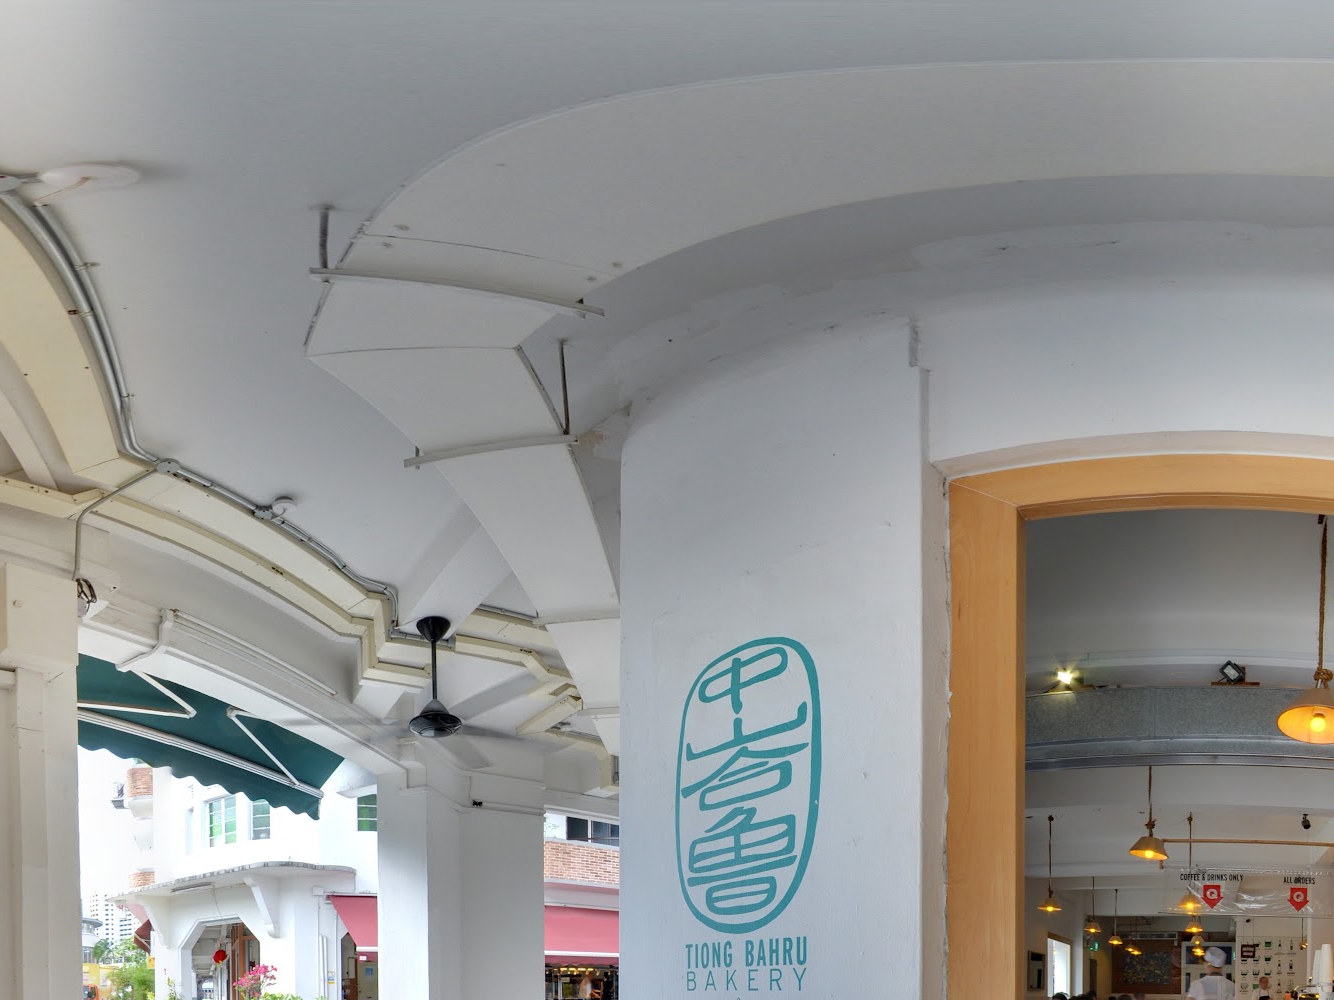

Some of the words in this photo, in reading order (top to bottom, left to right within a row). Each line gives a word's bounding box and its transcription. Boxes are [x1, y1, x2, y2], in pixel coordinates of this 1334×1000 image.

[1180, 873, 1200, 881] COFFEE
[1207, 874, 1228, 882] DRINKS
[1229, 874, 1244, 882] ONLY
[1283, 876, 1292, 884] ALL
[1294, 876, 1316, 885] ORDERS
[685, 940, 733, 969] TIONG
[745, 936, 807, 967] BAHRU
[686, 967, 807, 991] BAKERY
